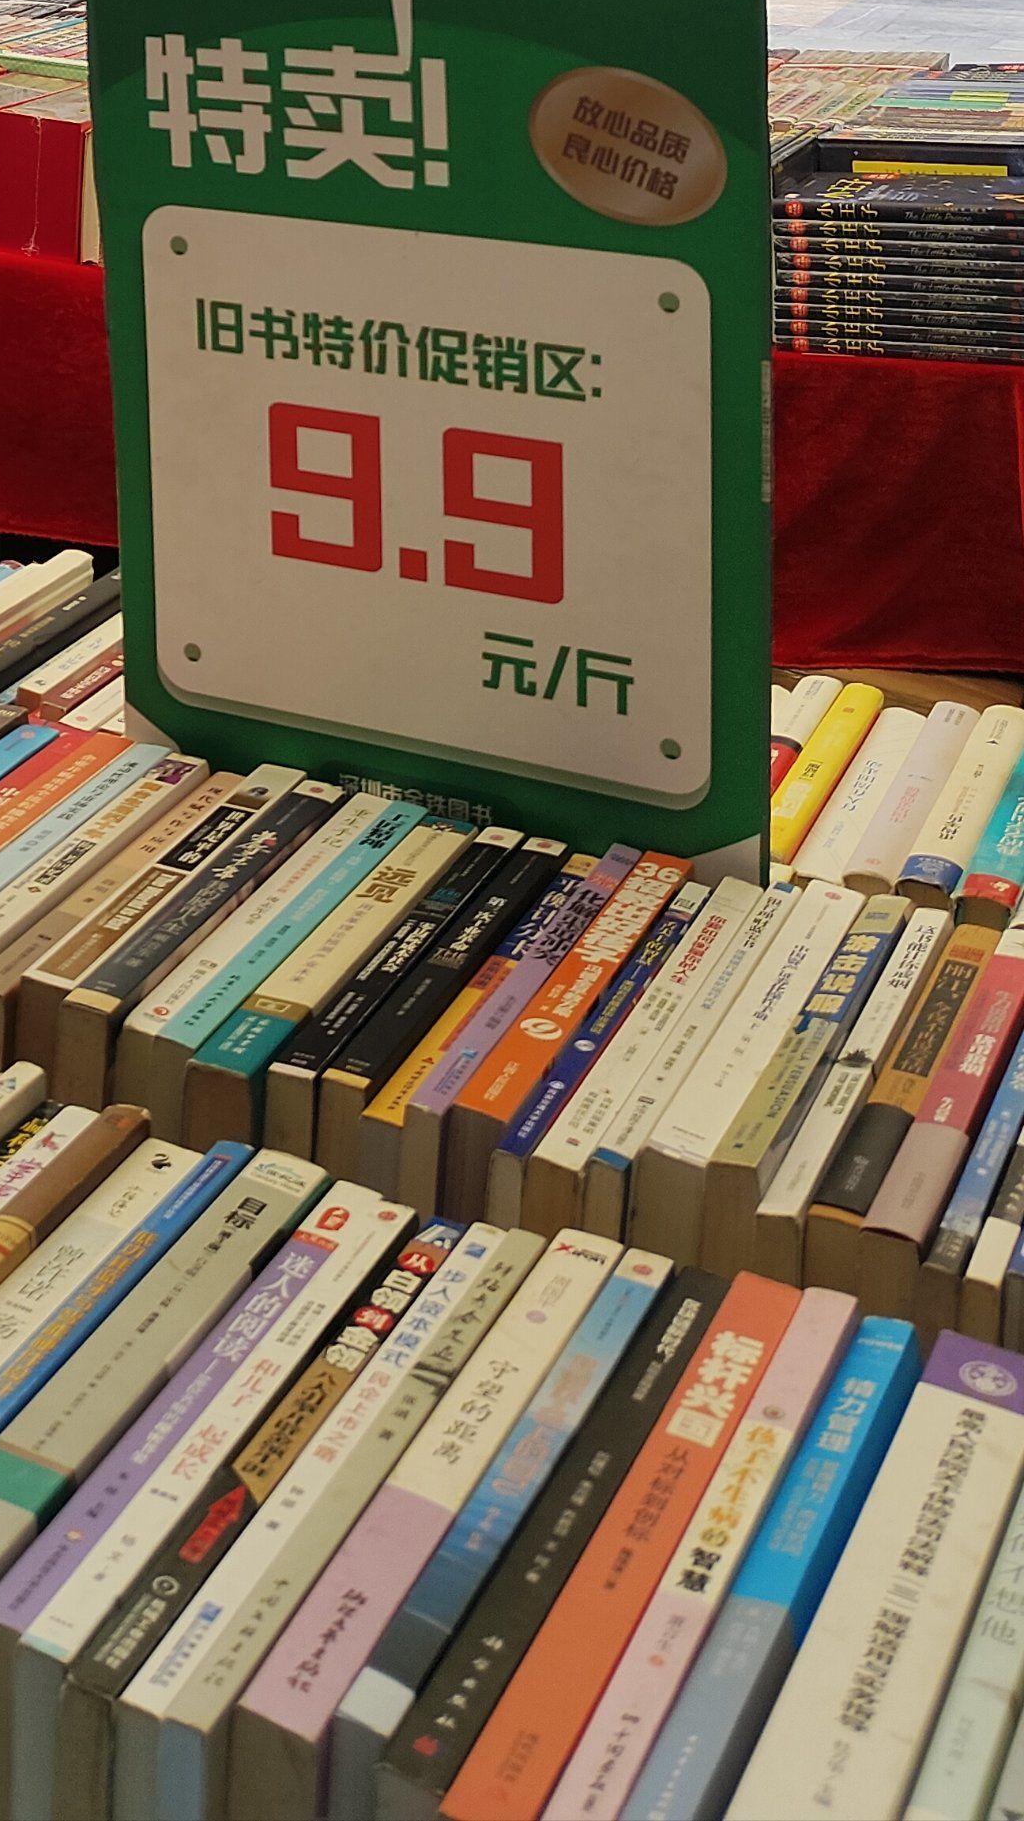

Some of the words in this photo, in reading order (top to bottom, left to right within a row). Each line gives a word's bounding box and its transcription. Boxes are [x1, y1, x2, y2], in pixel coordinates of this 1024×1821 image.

[144, 32, 451, 190] 特卖！
[571, 94, 693, 165] 放心品质
[561, 131, 680, 201] 良心价格
[817, 202, 878, 219] 小王子
[195, 297, 603, 402] 旧书特价促销区：
[268, 401, 564, 605] 9.9
[481, 631, 636, 717] 元/斤
[172, 809, 250, 866] 世界是平的
[354, 863, 422, 905] 远见
[525, 888, 611, 965] 化解渠道冲突
[566, 860, 689, 968] 36招教出好孩子
[801, 932, 882, 1018] 游击说服
[217, 1195, 270, 1233] 目标
[206, 1249, 320, 1364] 迷人的阅读
[315, 1247, 444, 1375] 从白领到金领
[376, 1266, 473, 1371] 步入资本模式
[425, 1355, 524, 1468] 守望的距离
[811, 1374, 881, 1456] 精力管理
[667, 1421, 784, 1598] 孩子不生病的智慧
